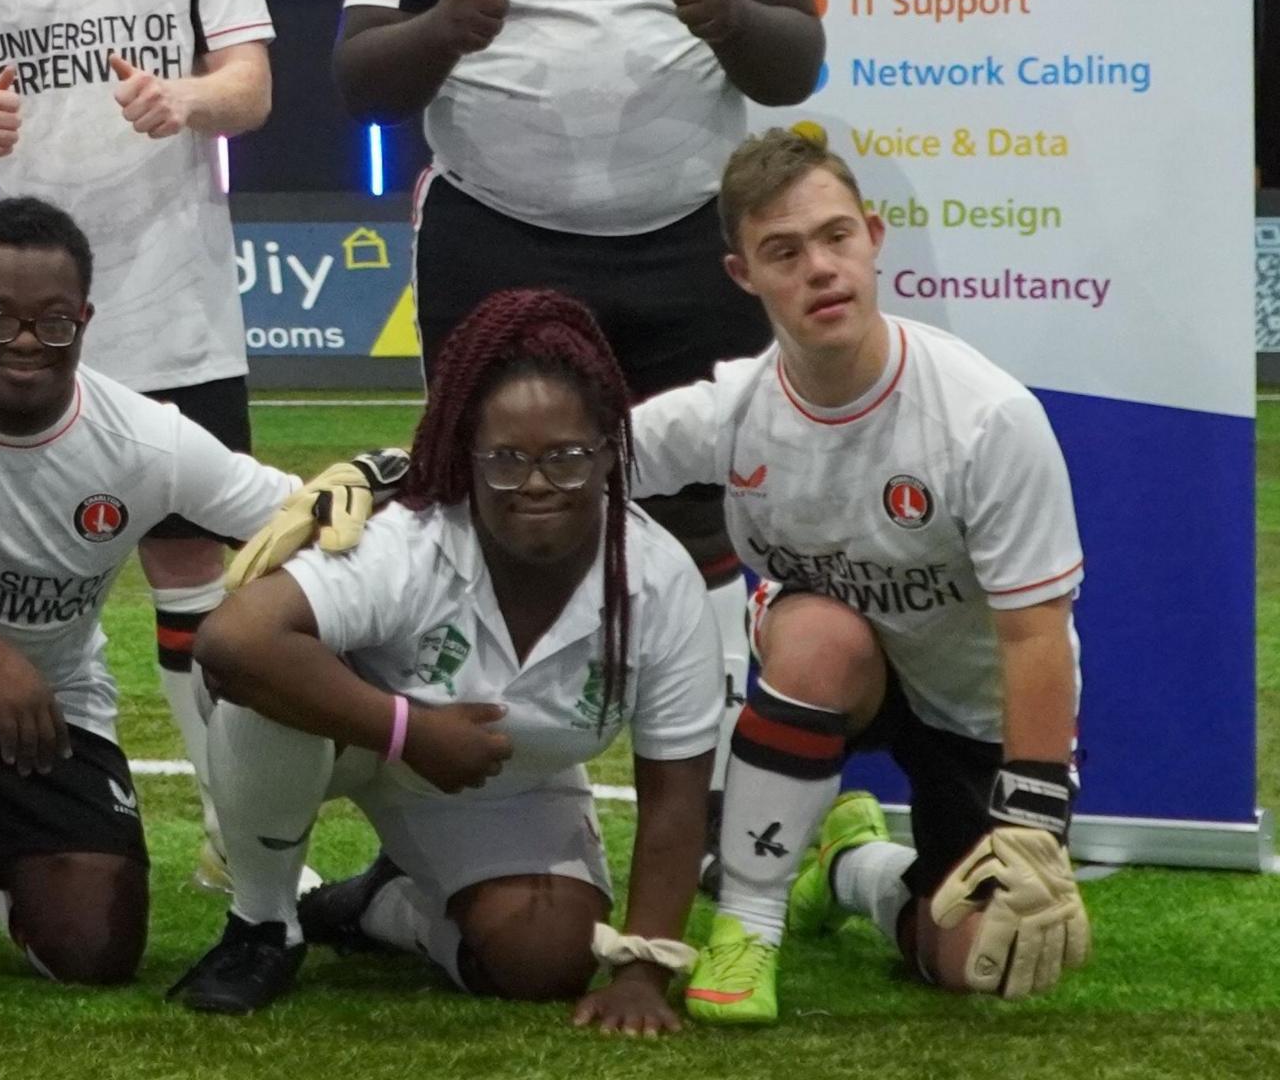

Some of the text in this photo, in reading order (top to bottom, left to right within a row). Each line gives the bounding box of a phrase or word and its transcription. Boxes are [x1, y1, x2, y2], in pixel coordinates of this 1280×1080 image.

[145, 14, 178, 42] OF
[851, 55, 1151, 93] Network Cabling
[851, 127, 1070, 158] Voice & Data
[942, 198, 1062, 236] Design
[894, 269, 1111, 308] Consultancy
[246, 326, 345, 349] ooms
